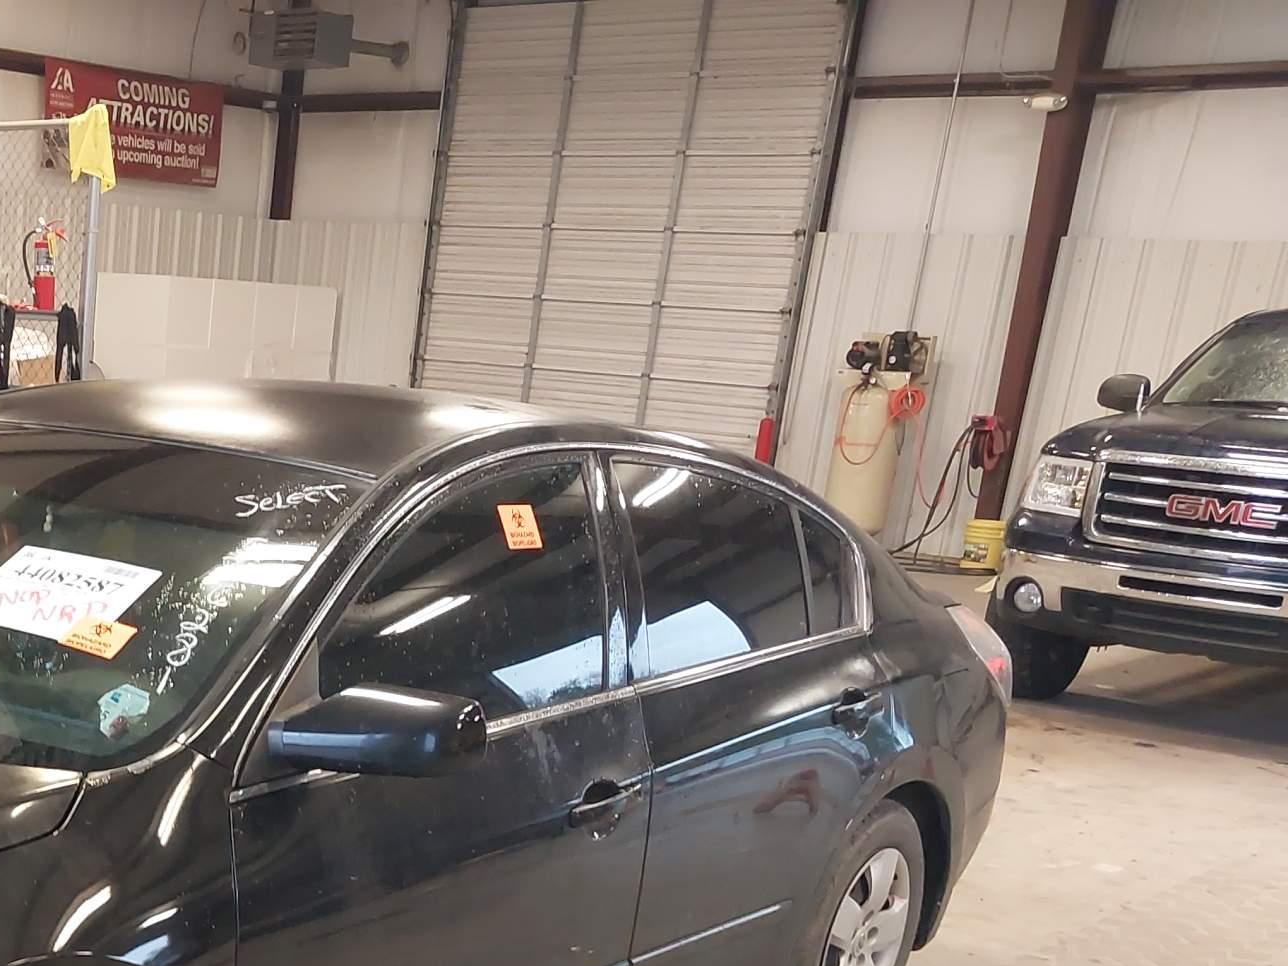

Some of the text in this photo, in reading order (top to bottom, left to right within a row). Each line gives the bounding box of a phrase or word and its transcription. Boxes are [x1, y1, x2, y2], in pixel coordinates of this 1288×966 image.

[117, 79, 190, 108] COMING
[117, 134, 155, 150] vehicles
[157, 139, 172, 152] will
[173, 140, 187, 154] be
[188, 144, 206, 156] sold
[117, 150, 162, 168] upcoming
[164, 155, 200, 169] auction!
[1165, 493, 1283, 530] GMC
[14, 563, 127, 596] 44082587
